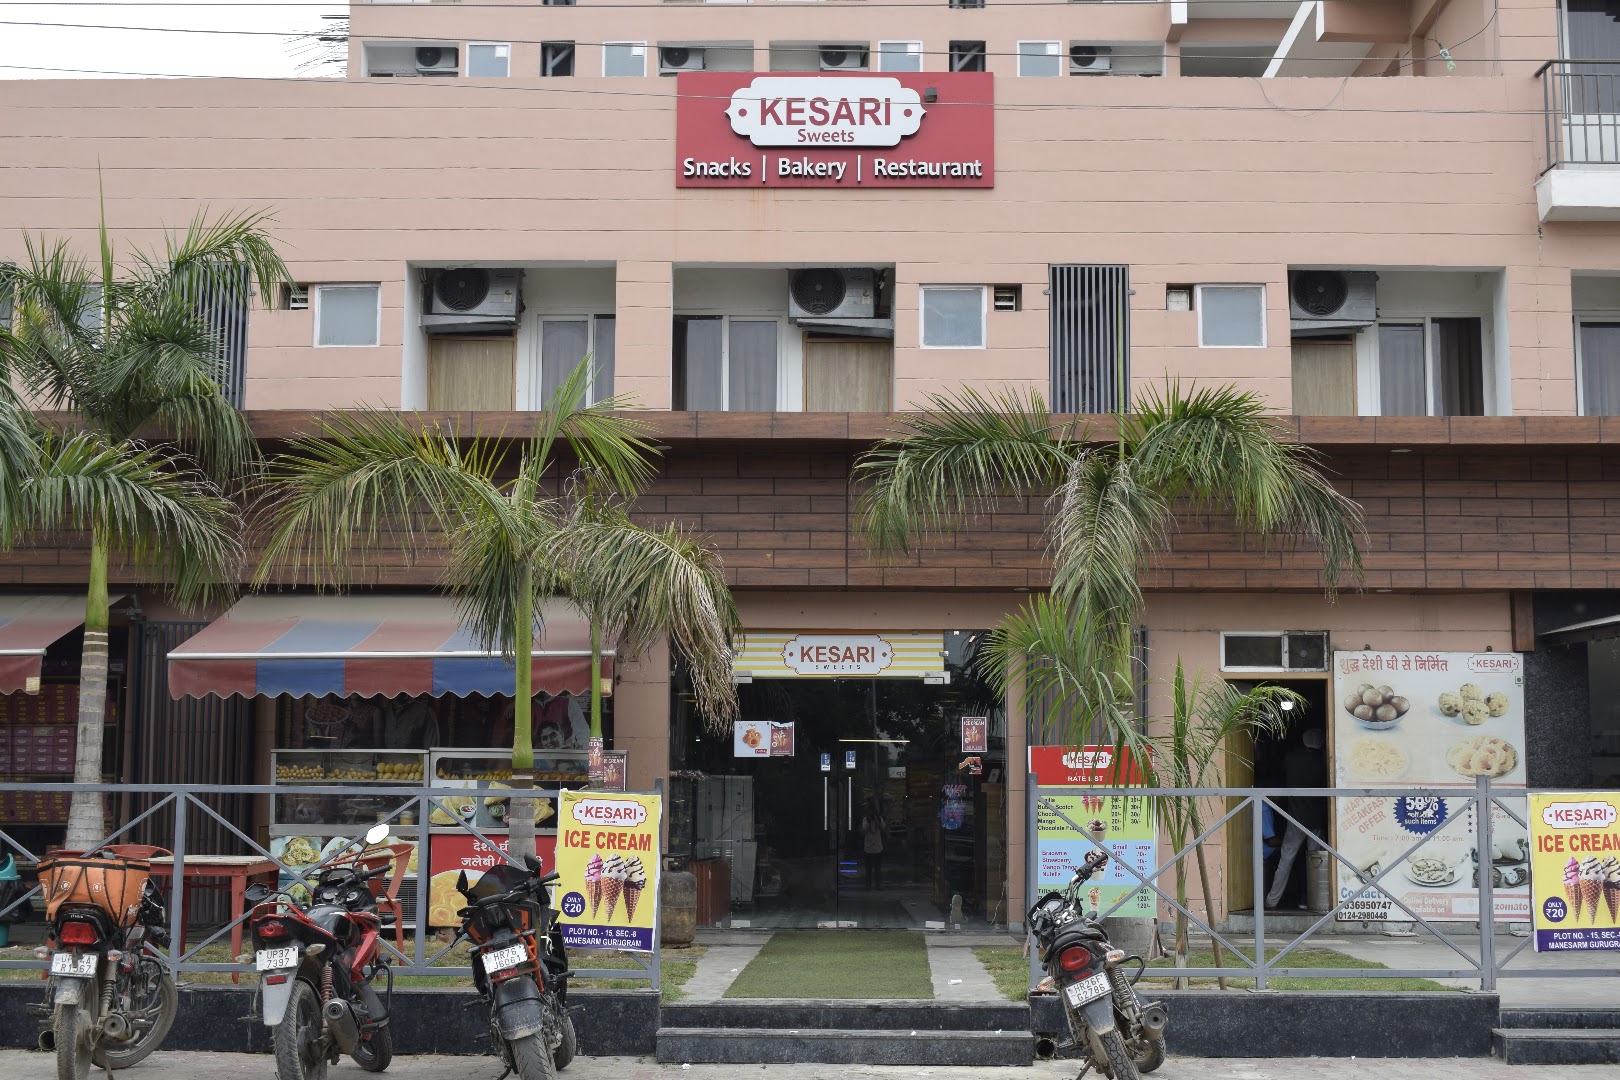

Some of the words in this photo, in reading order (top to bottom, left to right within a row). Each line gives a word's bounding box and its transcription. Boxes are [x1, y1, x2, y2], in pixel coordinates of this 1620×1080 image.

[760, 97, 891, 126] KESARI
[797, 128, 854, 143] Sweets
[683, 157, 752, 178] Snacks
[778, 157, 847, 180] Bakery
[874, 158, 983, 178] Restaurant
[800, 645, 875, 663] KESARI
[1362, 653, 1383, 671] देशी
[1386, 656, 1399, 671] घी
[1401, 655, 1411, 671] से
[1414, 654, 1449, 671] निर्मित
[1476, 659, 1512, 668] KESARI
[584, 805, 637, 820] KESARI
[1342, 796, 1388, 831] BREAKFAS
[1555, 808, 1607, 822] KESARI
[1358, 810, 1387, 834] OFFER
[564, 829, 590, 849] ICE
[595, 831, 652, 851] CREAM
[1537, 835, 1565, 852] ICE
[461, 855, 495, 867] जलेबी
[1341, 887, 1382, 899] Cotact
[1494, 903, 1528, 911] zomato
[1338, 911, 1388, 920] 0124-2980448
[568, 927, 587, 935] PLOT
[587, 928, 600, 936] NO.
[1553, 932, 1571, 940] PLOT
[1549, 940, 1588, 949] MANESARM
[267, 949, 290, 959] UP37
[494, 948, 517, 961] HR76
[267, 958, 290, 968] 7397
[1073, 974, 1101, 993] HR26F
[1077, 983, 1106, 1001] G2786
